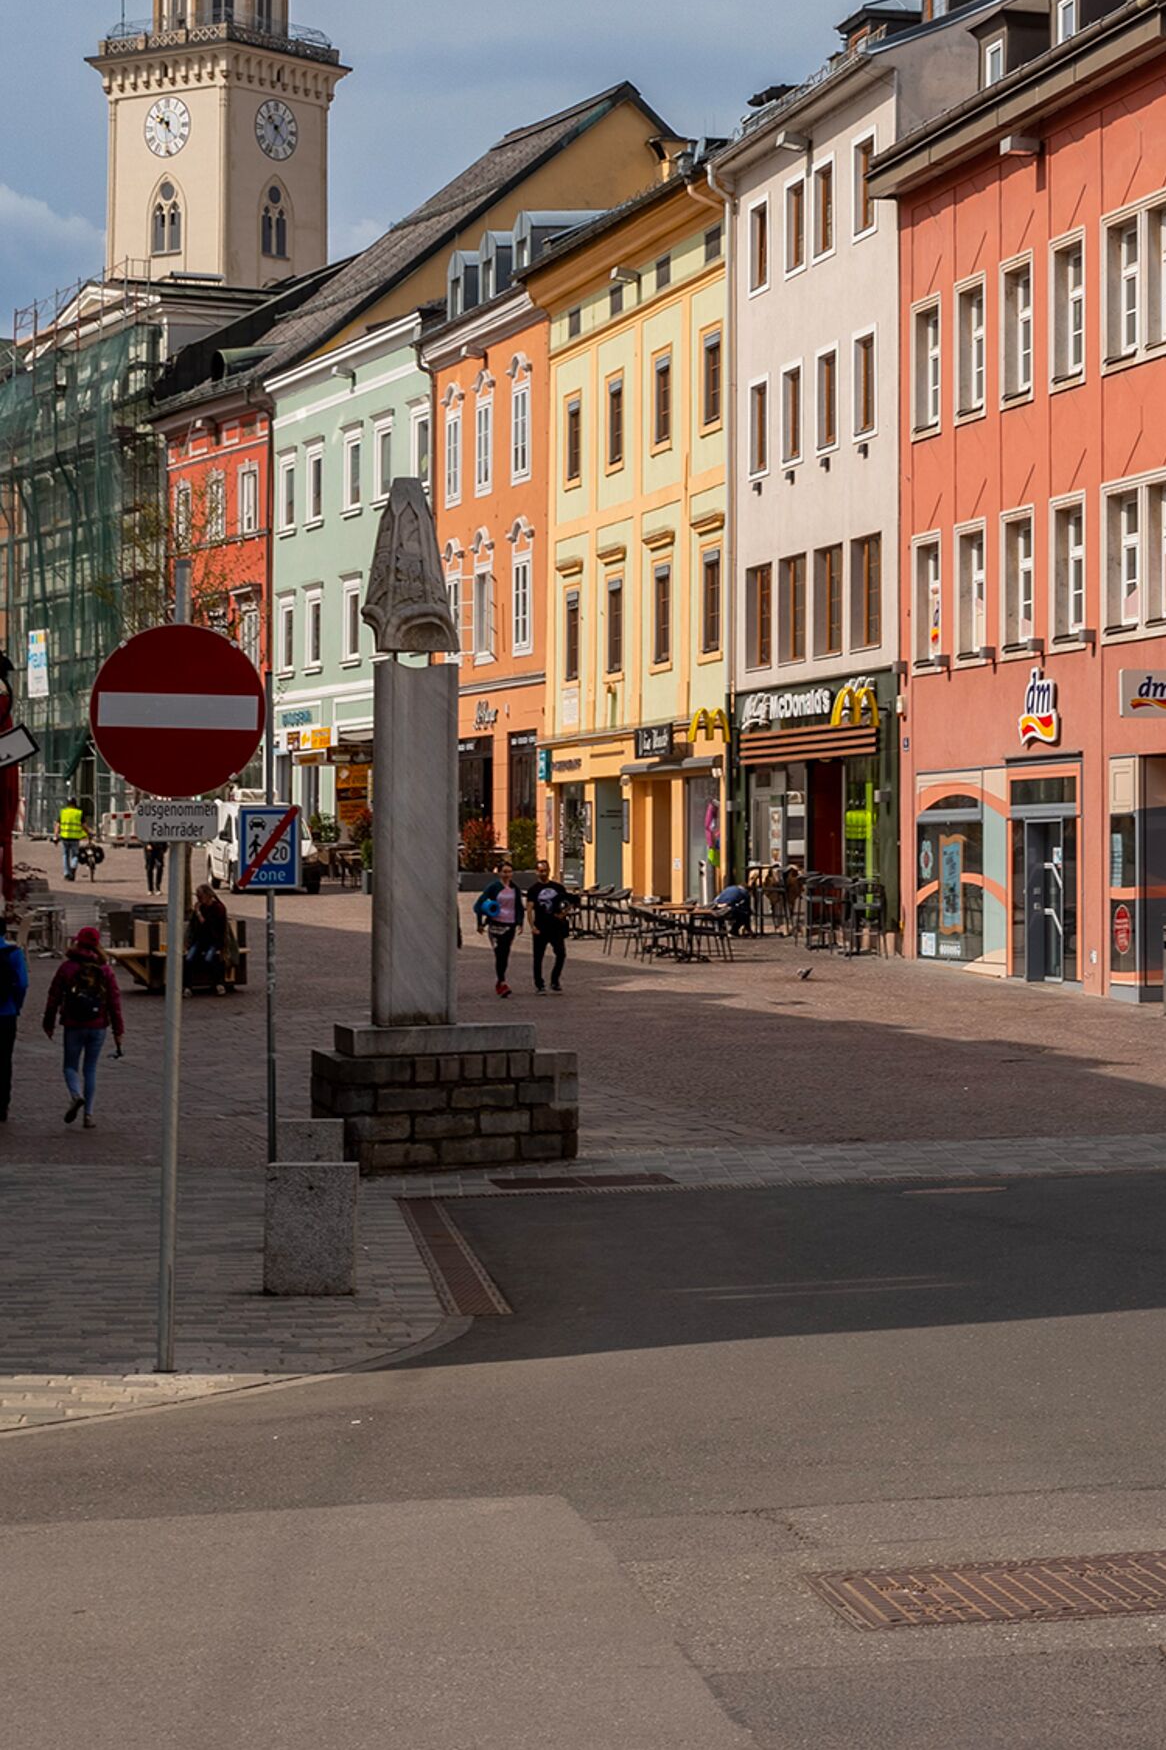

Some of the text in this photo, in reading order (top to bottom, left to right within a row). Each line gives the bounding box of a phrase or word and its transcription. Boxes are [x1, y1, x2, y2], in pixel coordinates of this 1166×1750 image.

[1027, 672, 1051, 714] dm
[769, 688, 831, 720] McDonald's
[137, 802, 217, 819] ausgenommen
[151, 821, 204, 837] Fahrräder
[271, 846, 288, 861] 20
[250, 868, 286, 882] Zone
